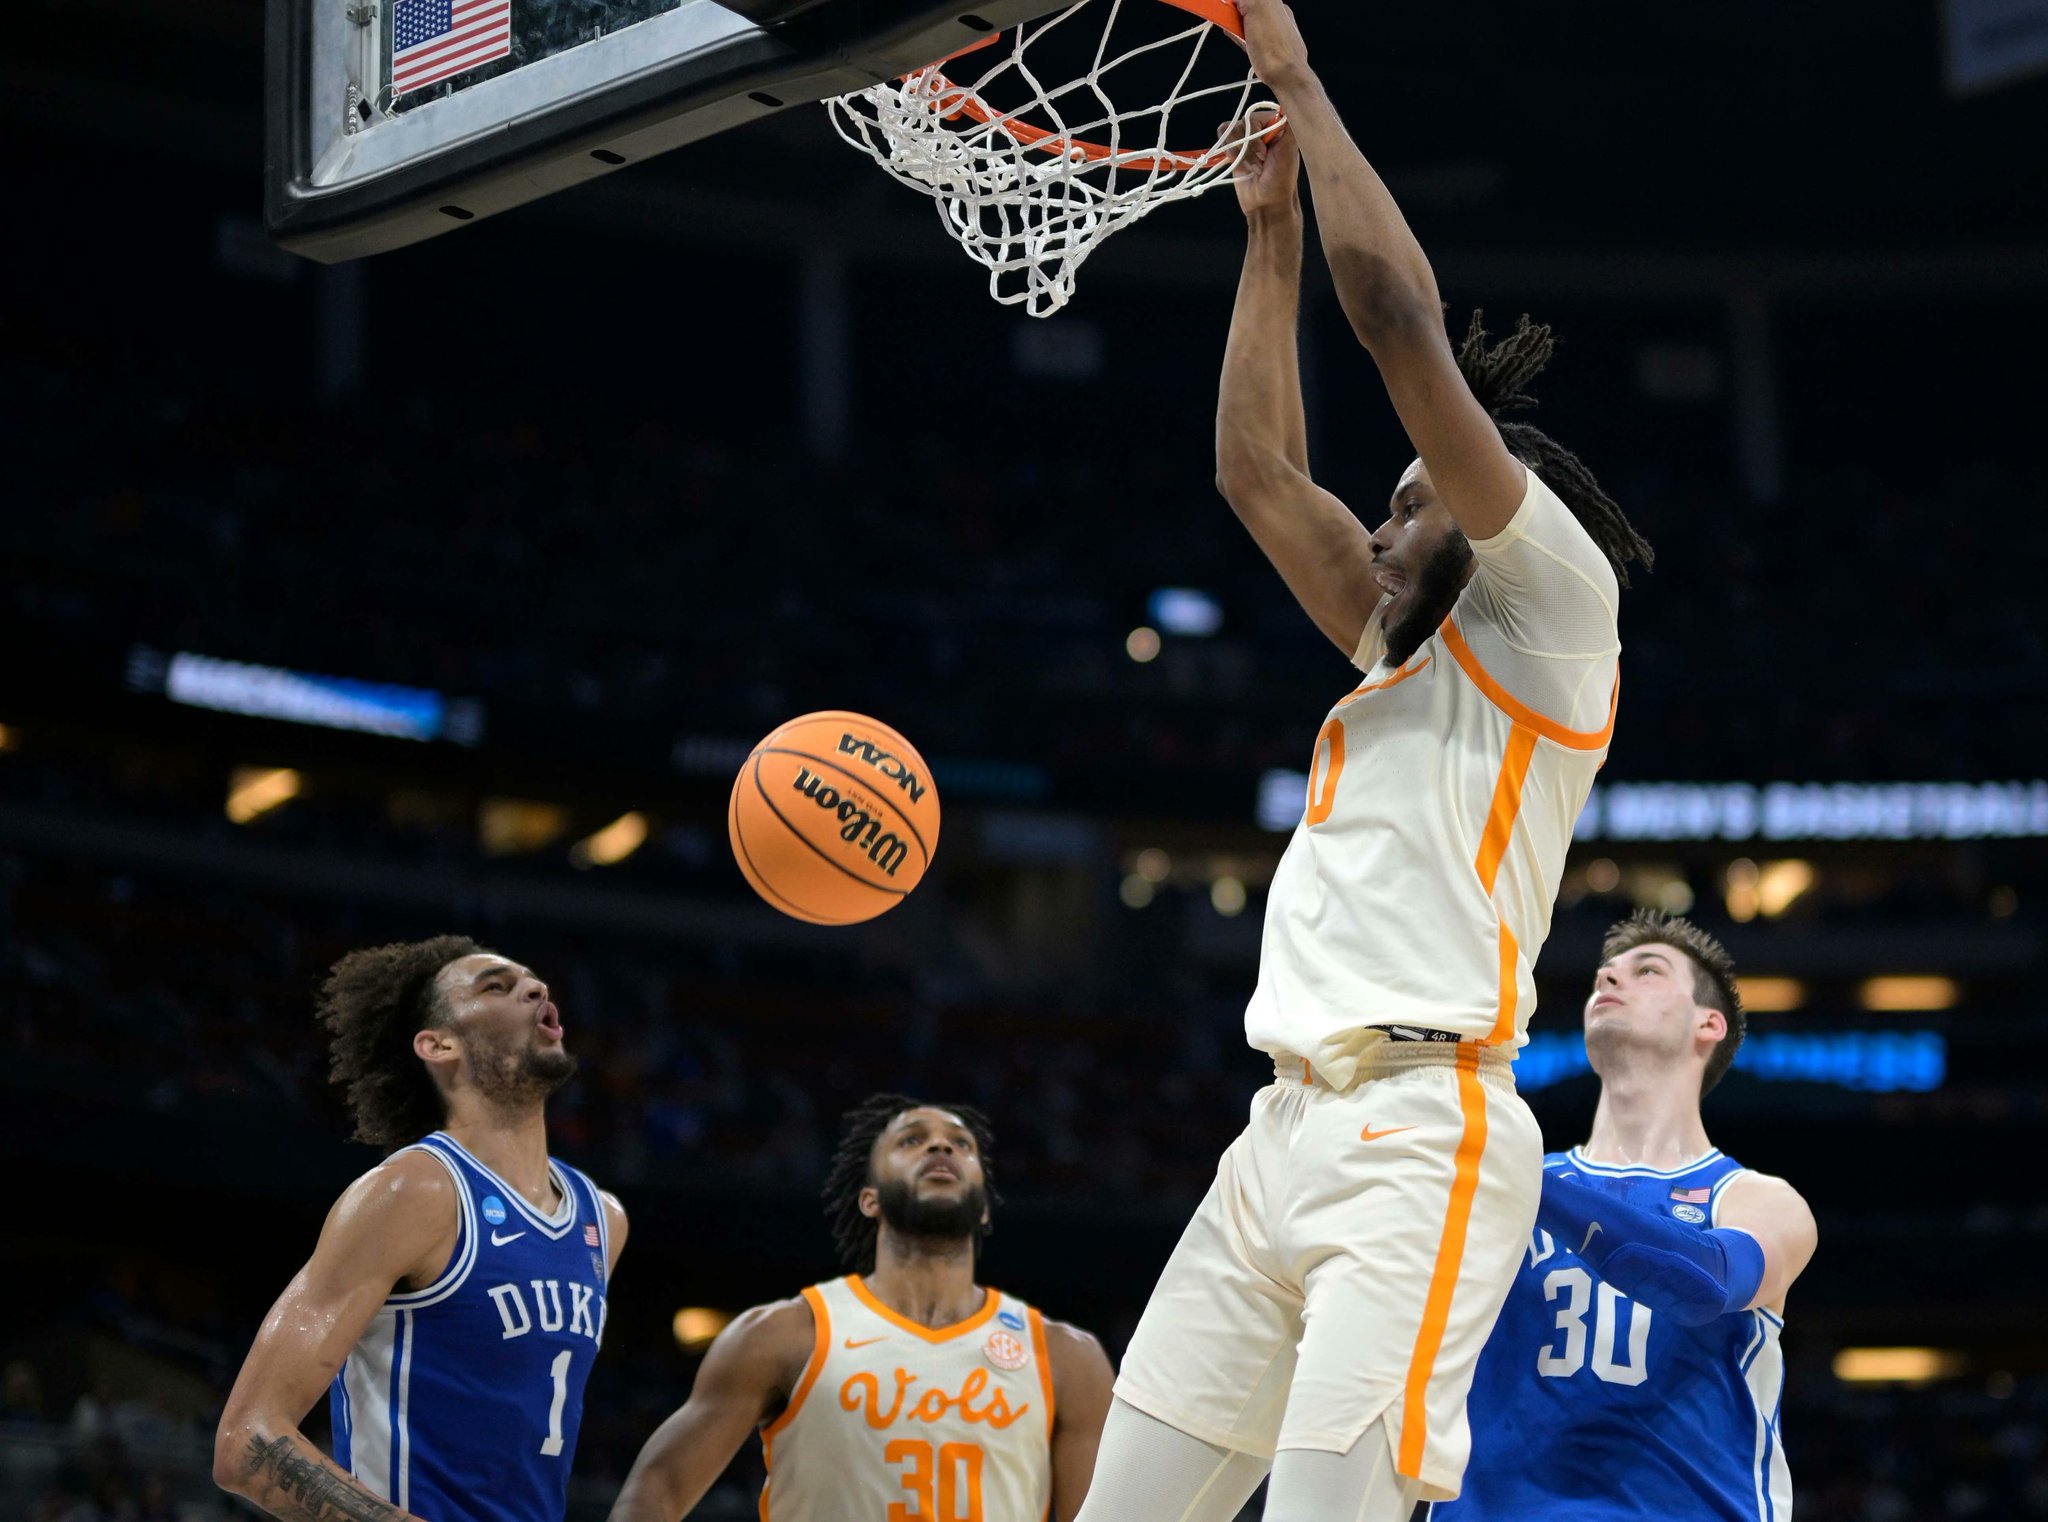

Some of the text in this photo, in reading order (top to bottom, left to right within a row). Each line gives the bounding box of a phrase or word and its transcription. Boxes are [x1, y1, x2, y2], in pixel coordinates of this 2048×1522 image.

[837, 732, 926, 804] NCAA
[793, 765, 908, 877] Wilson
[991, 1333, 1021, 1360] SEC
[1537, 1267, 1652, 1387] 30
[540, 1350, 572, 1457] 1
[839, 1367, 1029, 1431] Vols
[884, 1439, 983, 1522] 30
